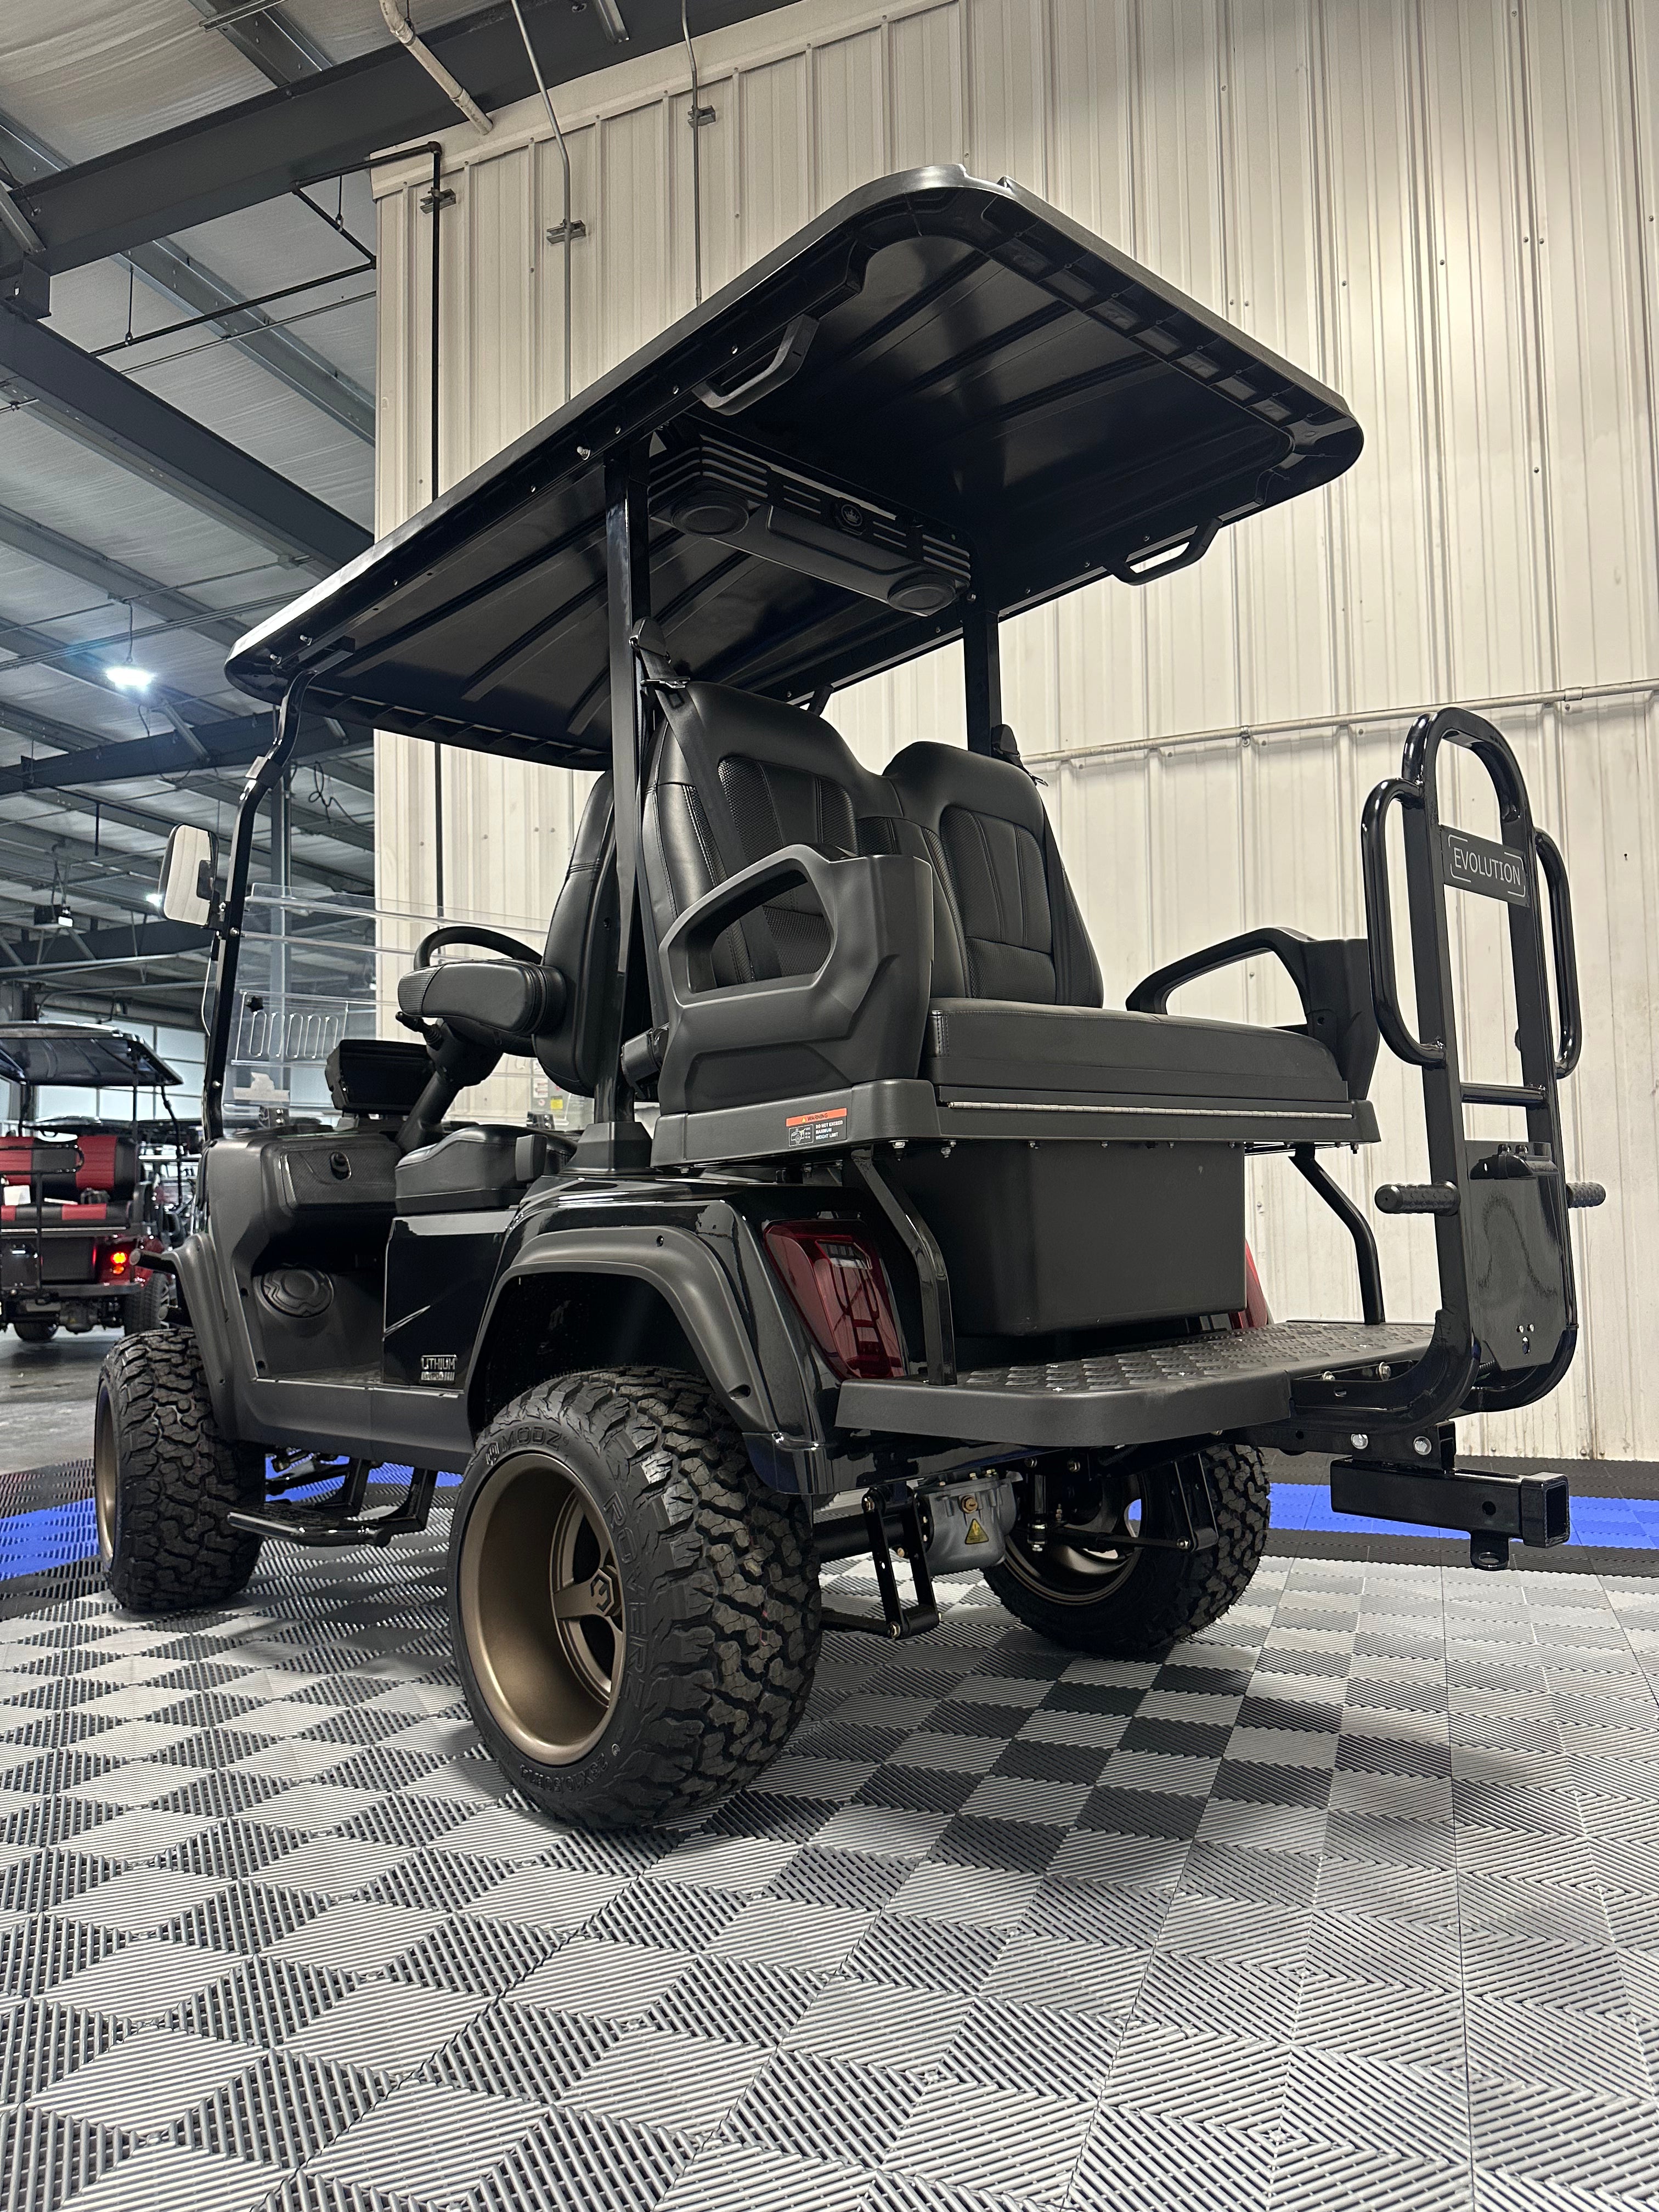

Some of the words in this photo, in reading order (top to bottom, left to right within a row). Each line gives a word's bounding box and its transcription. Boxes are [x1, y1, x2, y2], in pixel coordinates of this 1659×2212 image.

[1454, 847, 1521, 885] EVOLUTION
[421, 1357, 455, 1370] LITHIUM
[501, 1426, 562, 1453] MODZ
